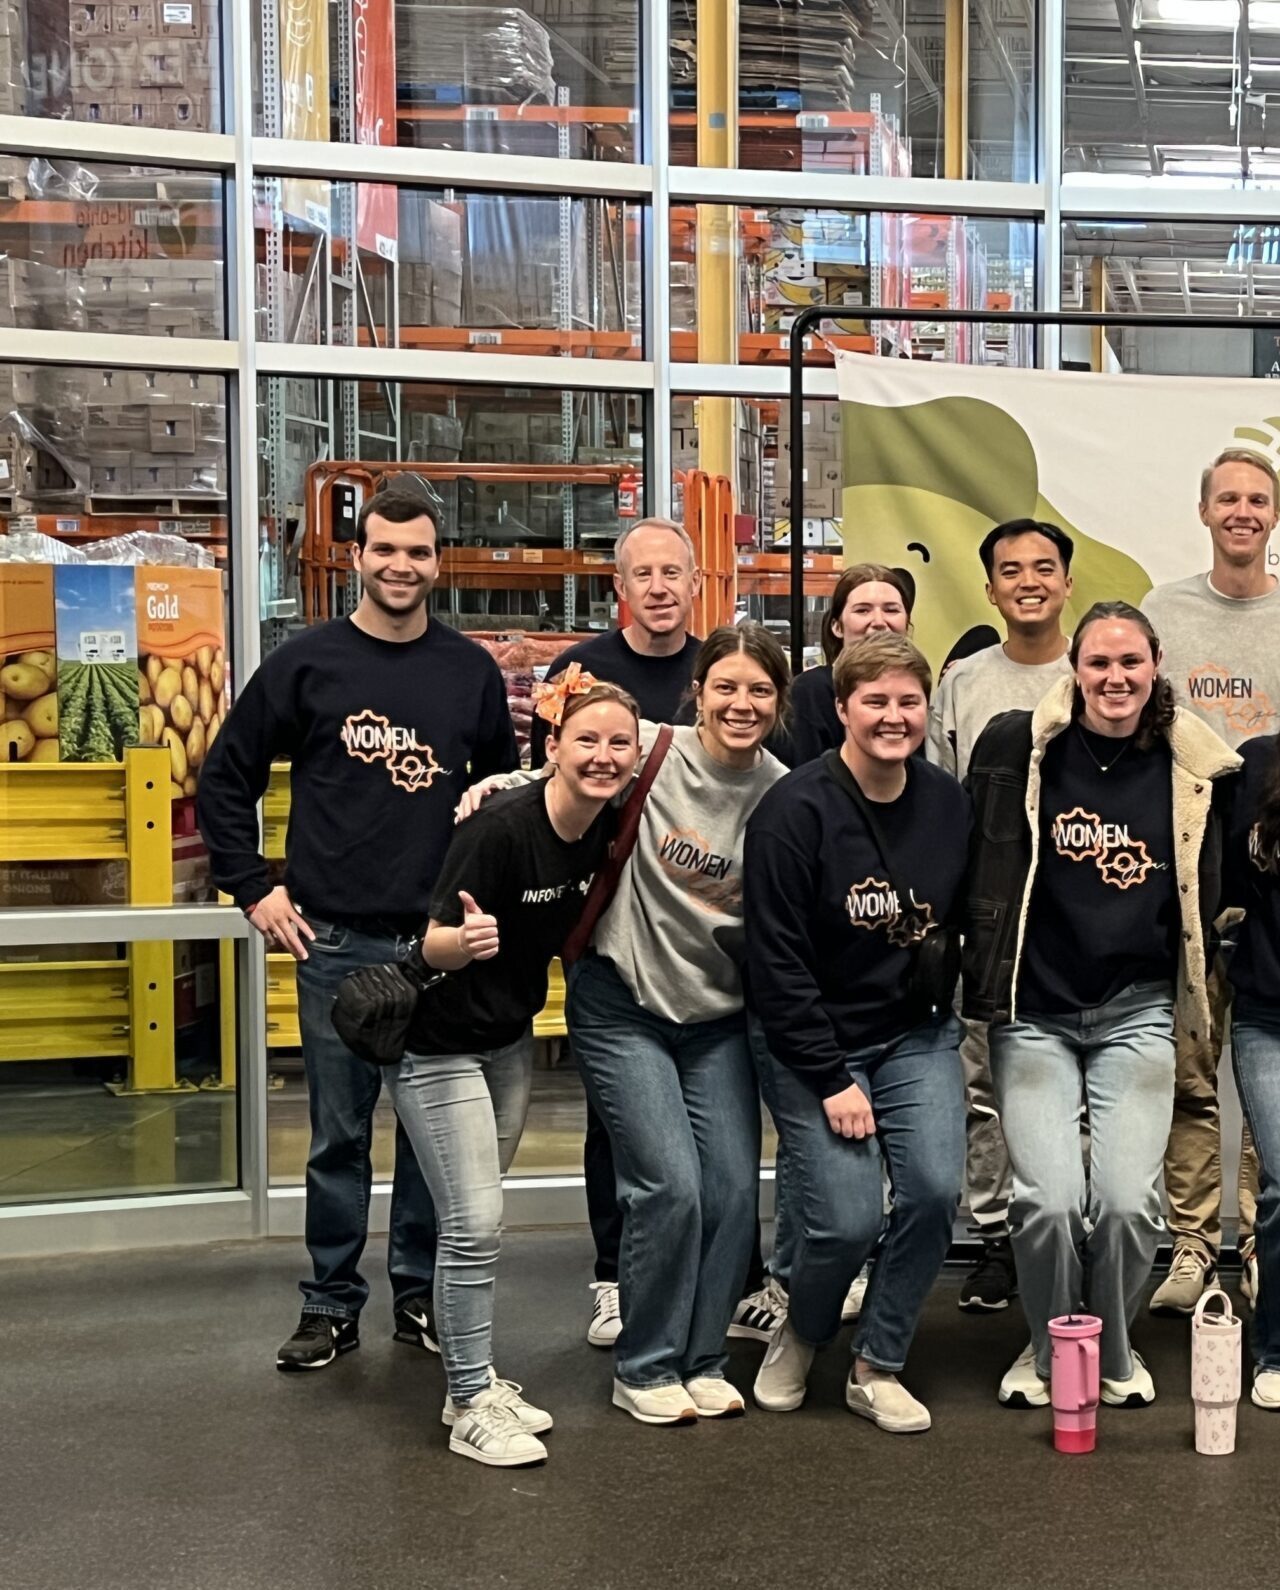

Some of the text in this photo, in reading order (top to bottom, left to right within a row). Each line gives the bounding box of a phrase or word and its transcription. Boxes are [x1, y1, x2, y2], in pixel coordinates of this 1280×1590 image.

[146, 594, 180, 620] Gold
[1188, 677, 1253, 699] WOMEN
[342, 725, 416, 751] WOMEN
[1052, 823, 1130, 848] WOMEN
[660, 834, 733, 880] WOMEN
